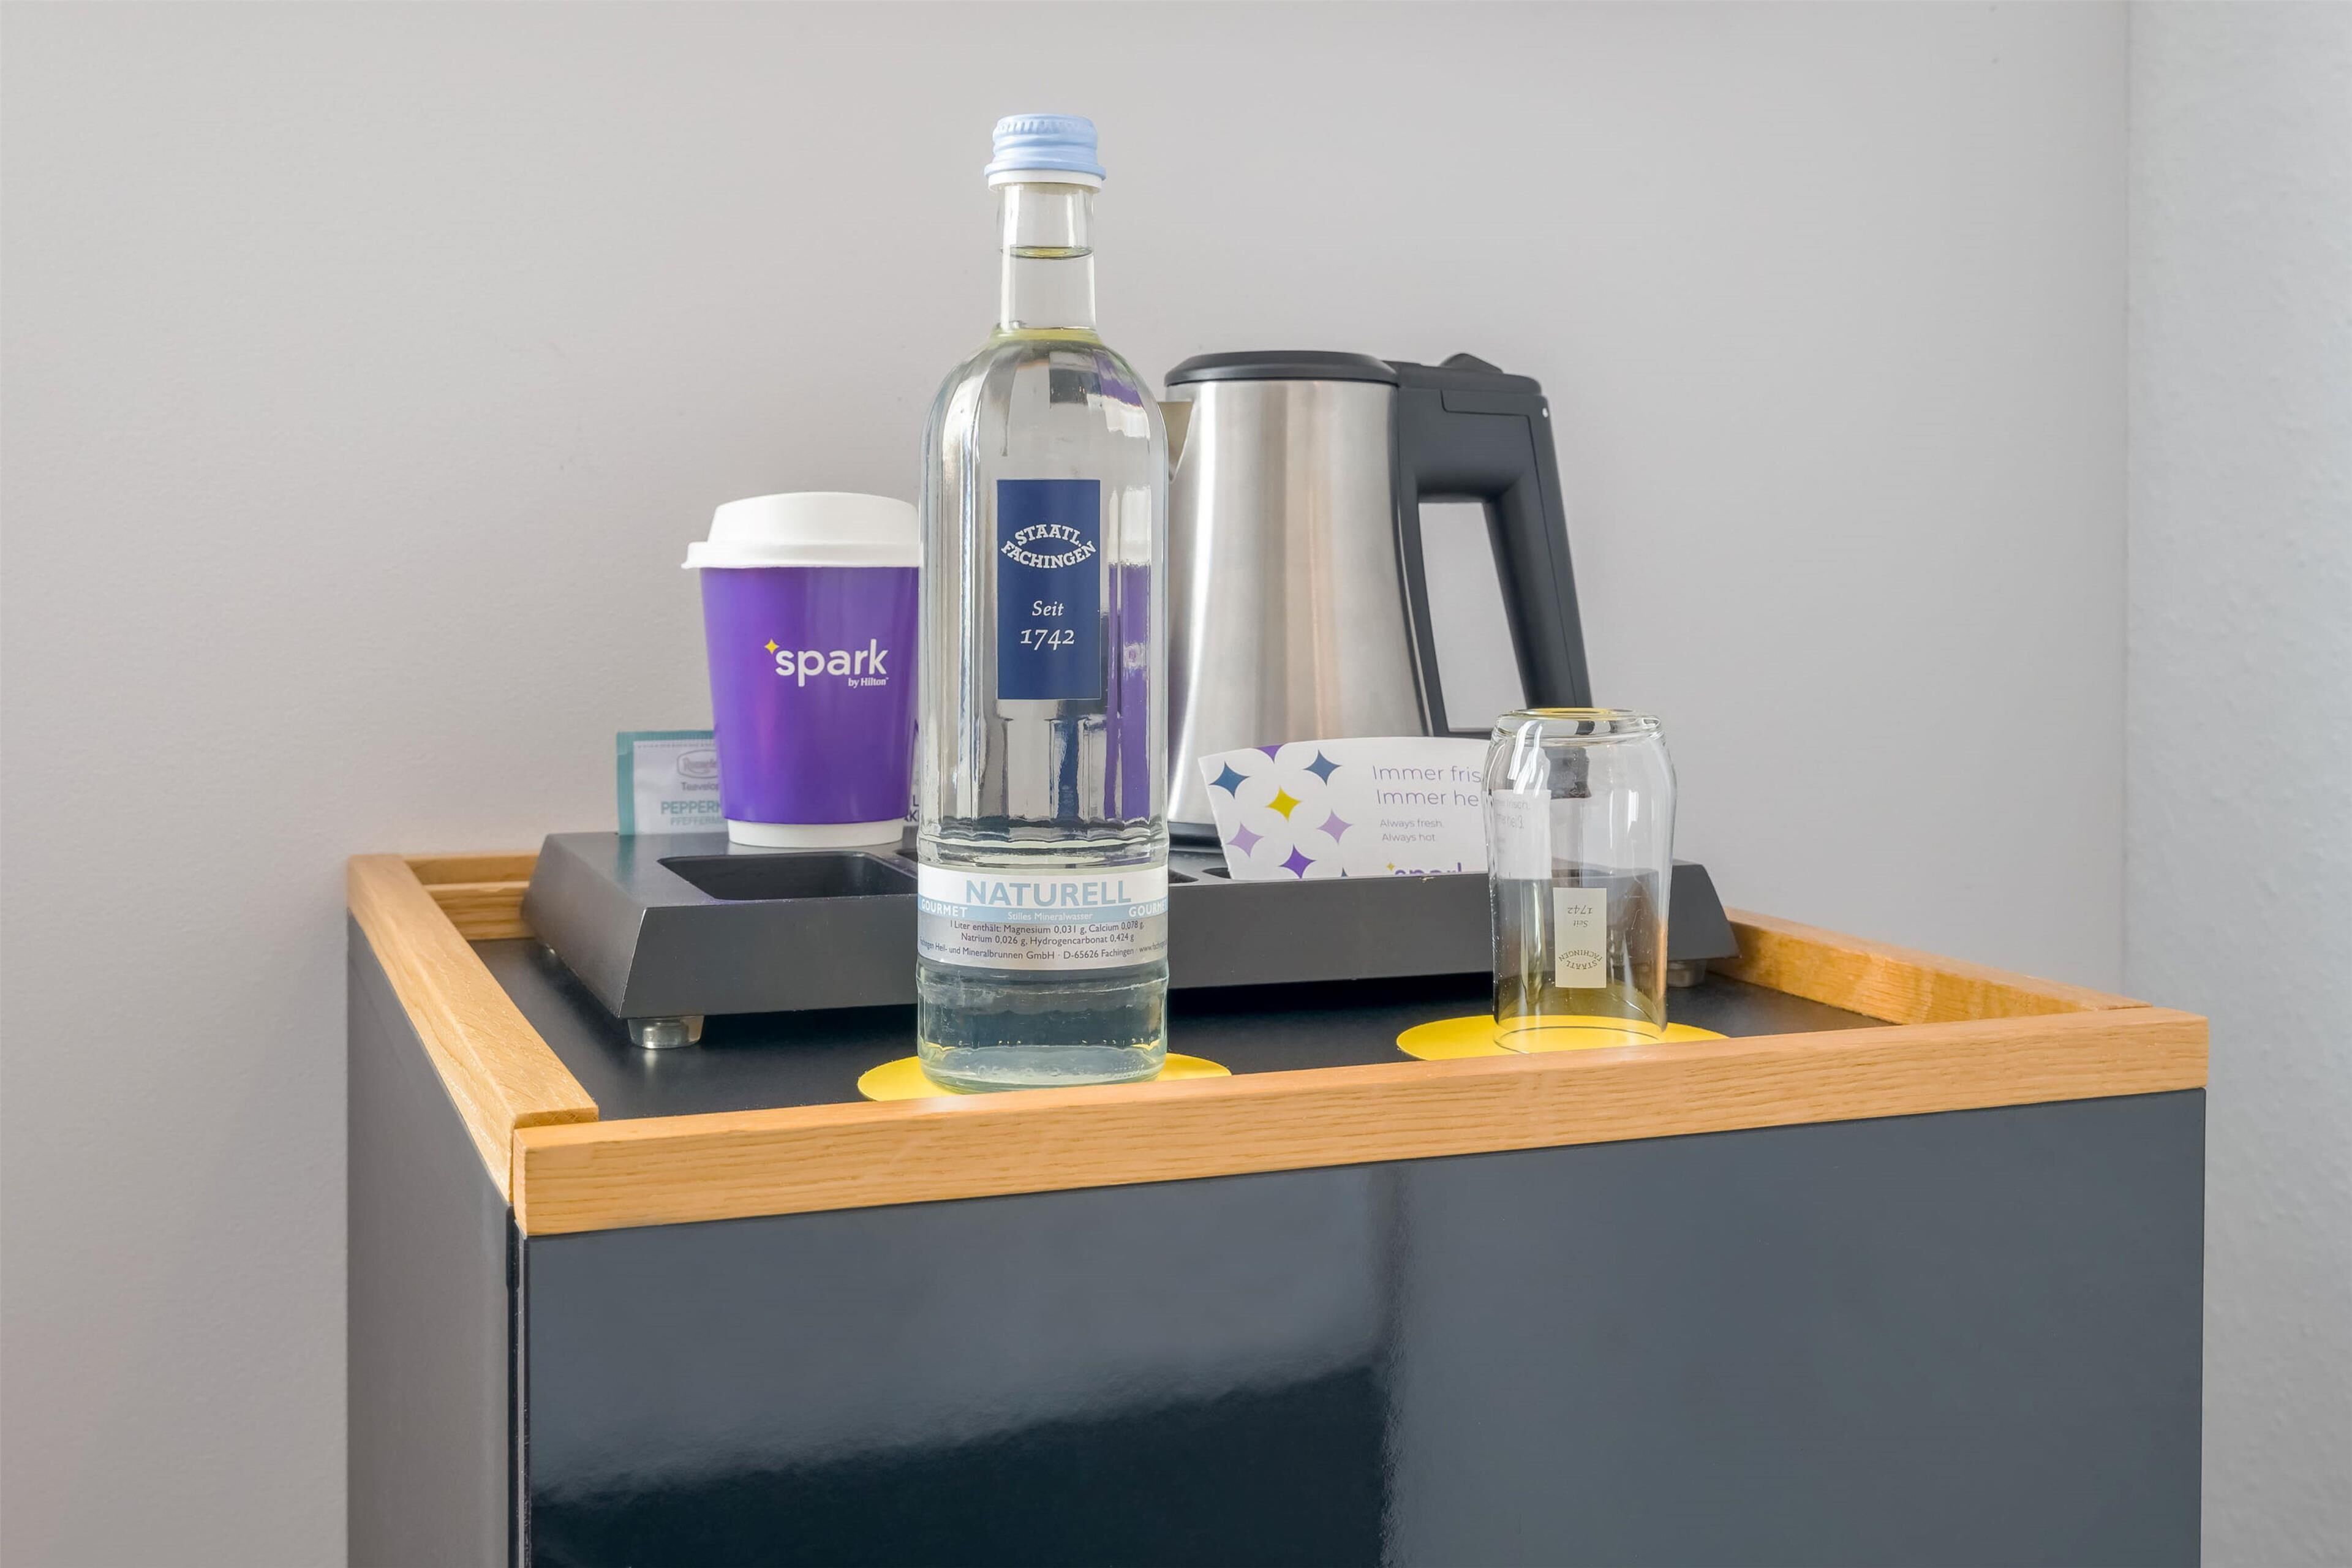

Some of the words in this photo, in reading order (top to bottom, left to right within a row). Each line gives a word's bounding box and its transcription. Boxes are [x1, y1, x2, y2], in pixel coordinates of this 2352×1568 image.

[1015, 524, 1082, 547] STAATL.
[1001, 540, 1096, 568] FACHINGEN
[1032, 600, 1064, 617] Seit
[1020, 629, 1075, 650] 1742
[775, 638, 889, 687] spark
[848, 677, 859, 688] by
[1373, 765, 1444, 780] Immer
[1450, 766, 1482, 783] fris
[1377, 789, 1446, 805] Immer
[1453, 790, 1479, 807] he
[1380, 819, 1415, 829] Always
[1382, 833, 1417, 843] Always
[966, 880, 1131, 907] NATURELL
[921, 899, 968, 918] GOURMET
[1008, 911, 1031, 921] Stilles
[1035, 912, 1093, 921] Mineralwasser
[1567, 905, 1593, 914] 1742
[954, 921, 970, 930] Liter
[1003, 924, 1051, 935] Magnesium
[1088, 924, 1119, 932] Calcium
[961, 933, 992, 943] Natrium
[1030, 933, 1108, 946] Hydrogencarbonat
[963, 948, 1023, 959] Mineralbrunnen
[1026, 951, 1054, 959] GmbH
[1063, 950, 1099, 959] D-65626
[1101, 948, 1134, 958] Fachingen
[1558, 949, 1603, 962] FACHINGEN
